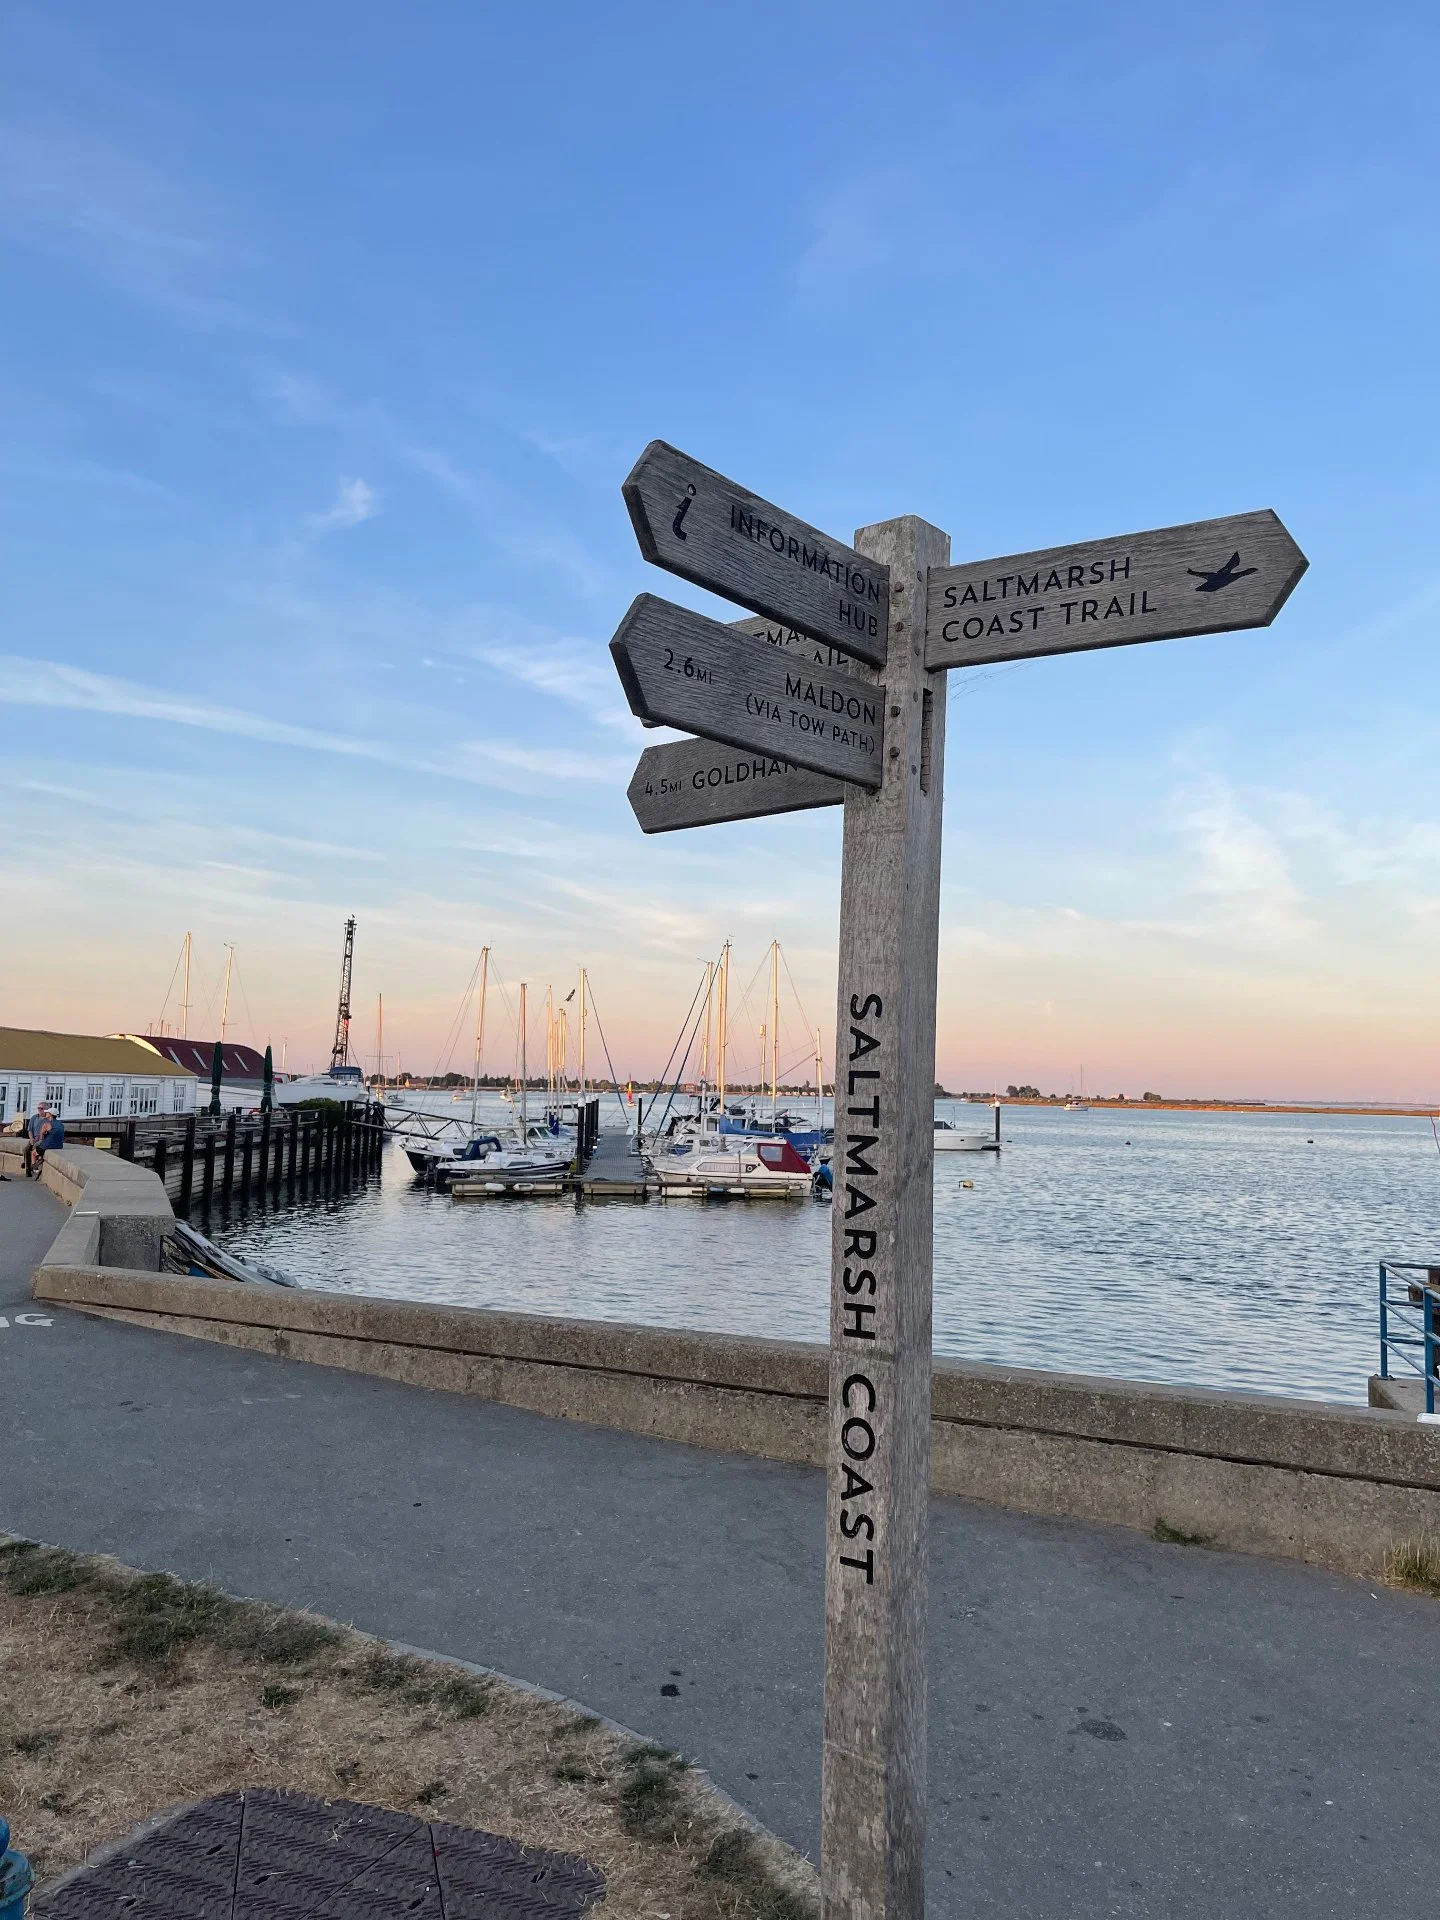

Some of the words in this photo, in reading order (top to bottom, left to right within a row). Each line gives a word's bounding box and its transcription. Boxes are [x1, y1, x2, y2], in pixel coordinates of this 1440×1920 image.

[730, 504, 880, 604] INFORMATION
[943, 556, 1131, 608] SALTMARSH
[839, 600, 878, 637] HUB
[942, 606, 1045, 643] COAST
[1059, 591, 1158, 626] TRAIL
[745, 692, 782, 723] (VIA
[789, 709, 825, 736] TOW
[832, 724, 875, 755] PATH)
[785, 672, 876, 726] MALDON
[843, 994, 882, 1341] SALTMARSH
[839, 1373, 876, 1585] COAST
